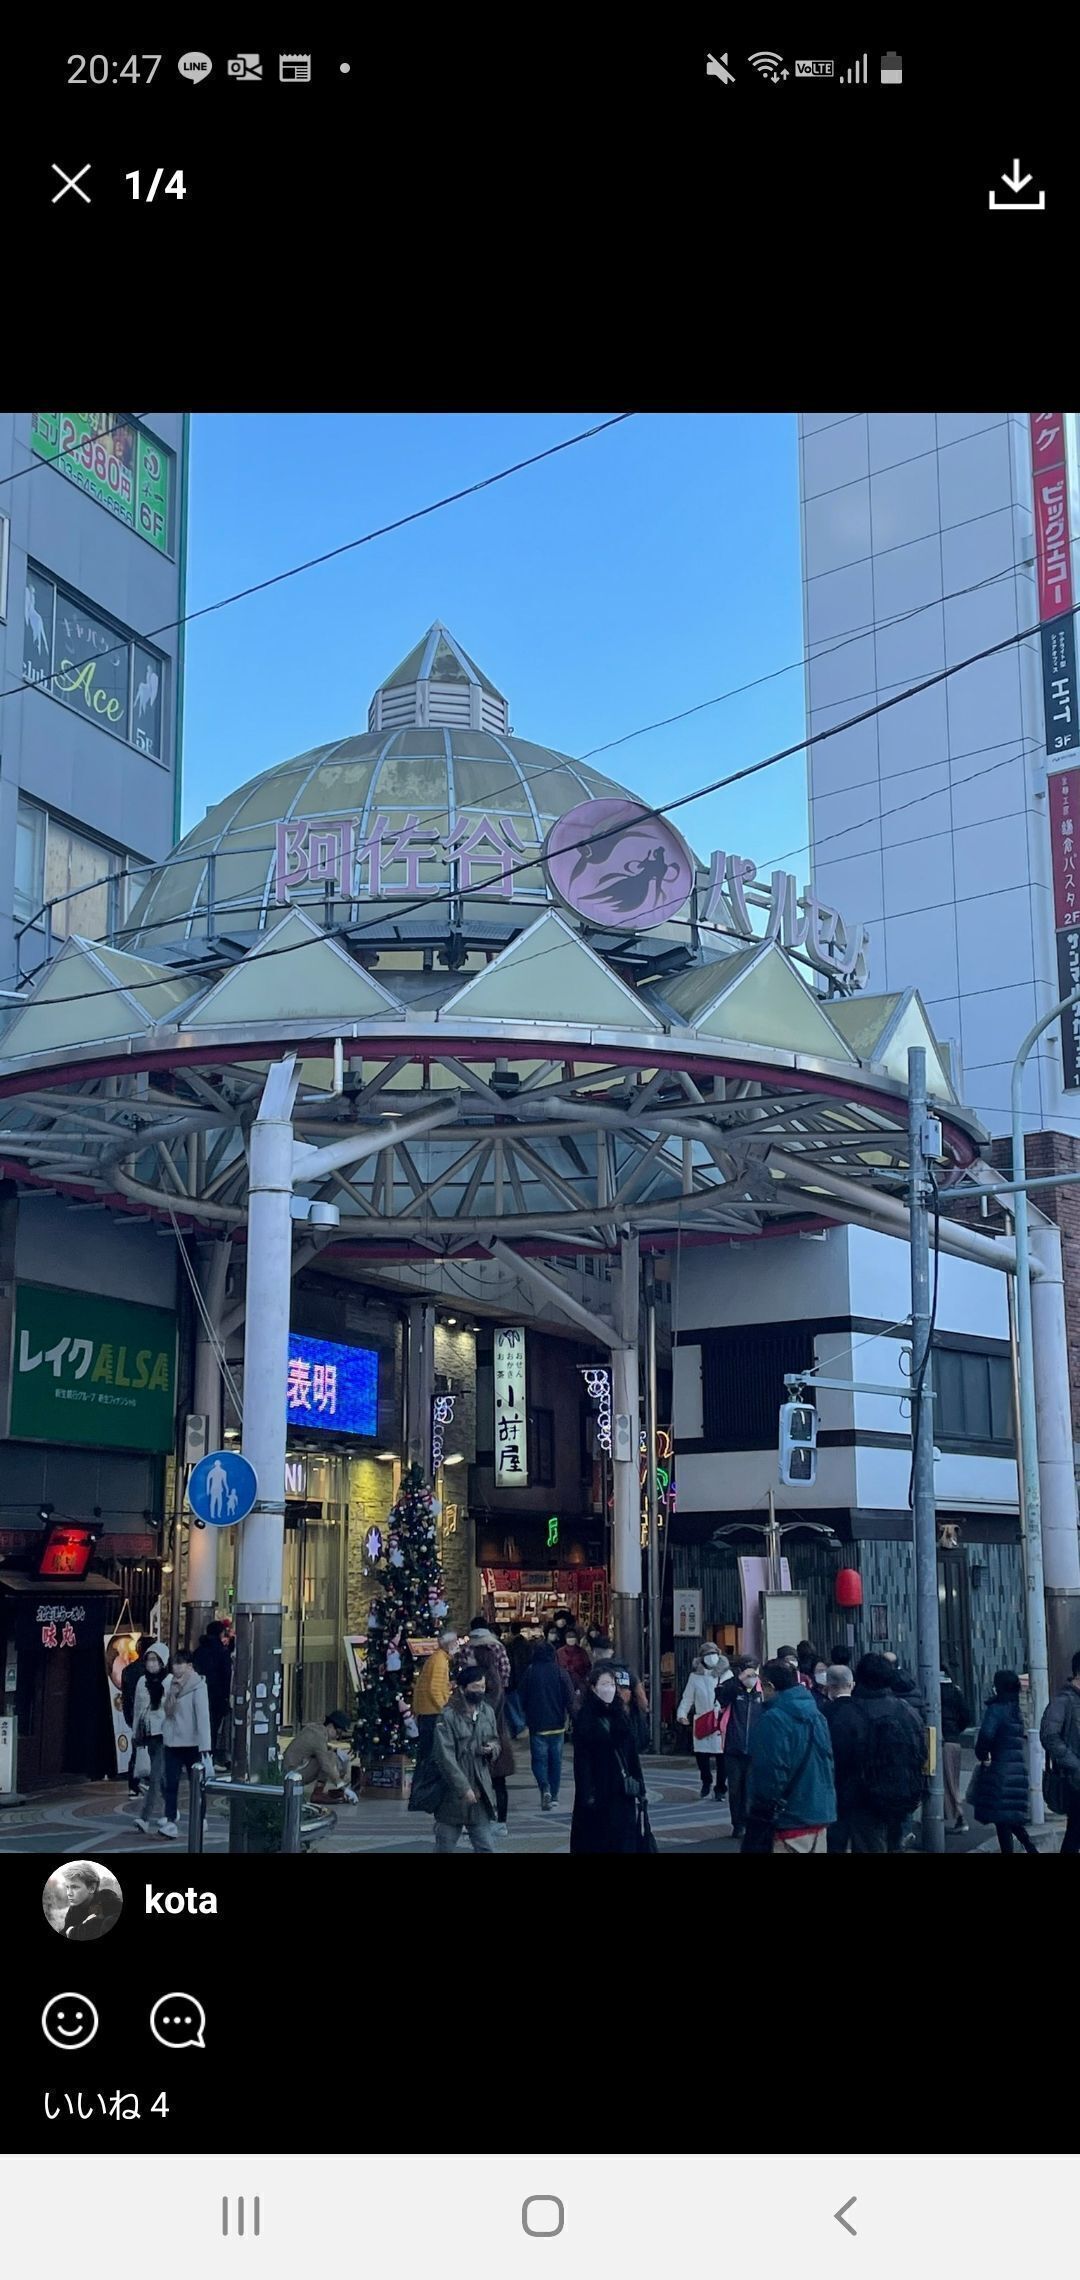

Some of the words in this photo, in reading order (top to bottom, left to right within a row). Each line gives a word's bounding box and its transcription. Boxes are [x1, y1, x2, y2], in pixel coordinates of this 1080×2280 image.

[63, 419, 131, 503] 2,980円
[140, 502, 164, 536] 6F
[53, 659, 124, 722] Ace
[1054, 733, 1072, 748] 3F
[274, 813, 528, 903] 阿佐谷
[1064, 911, 1080, 925] 2F
[287, 1356, 337, 1415] 表明
